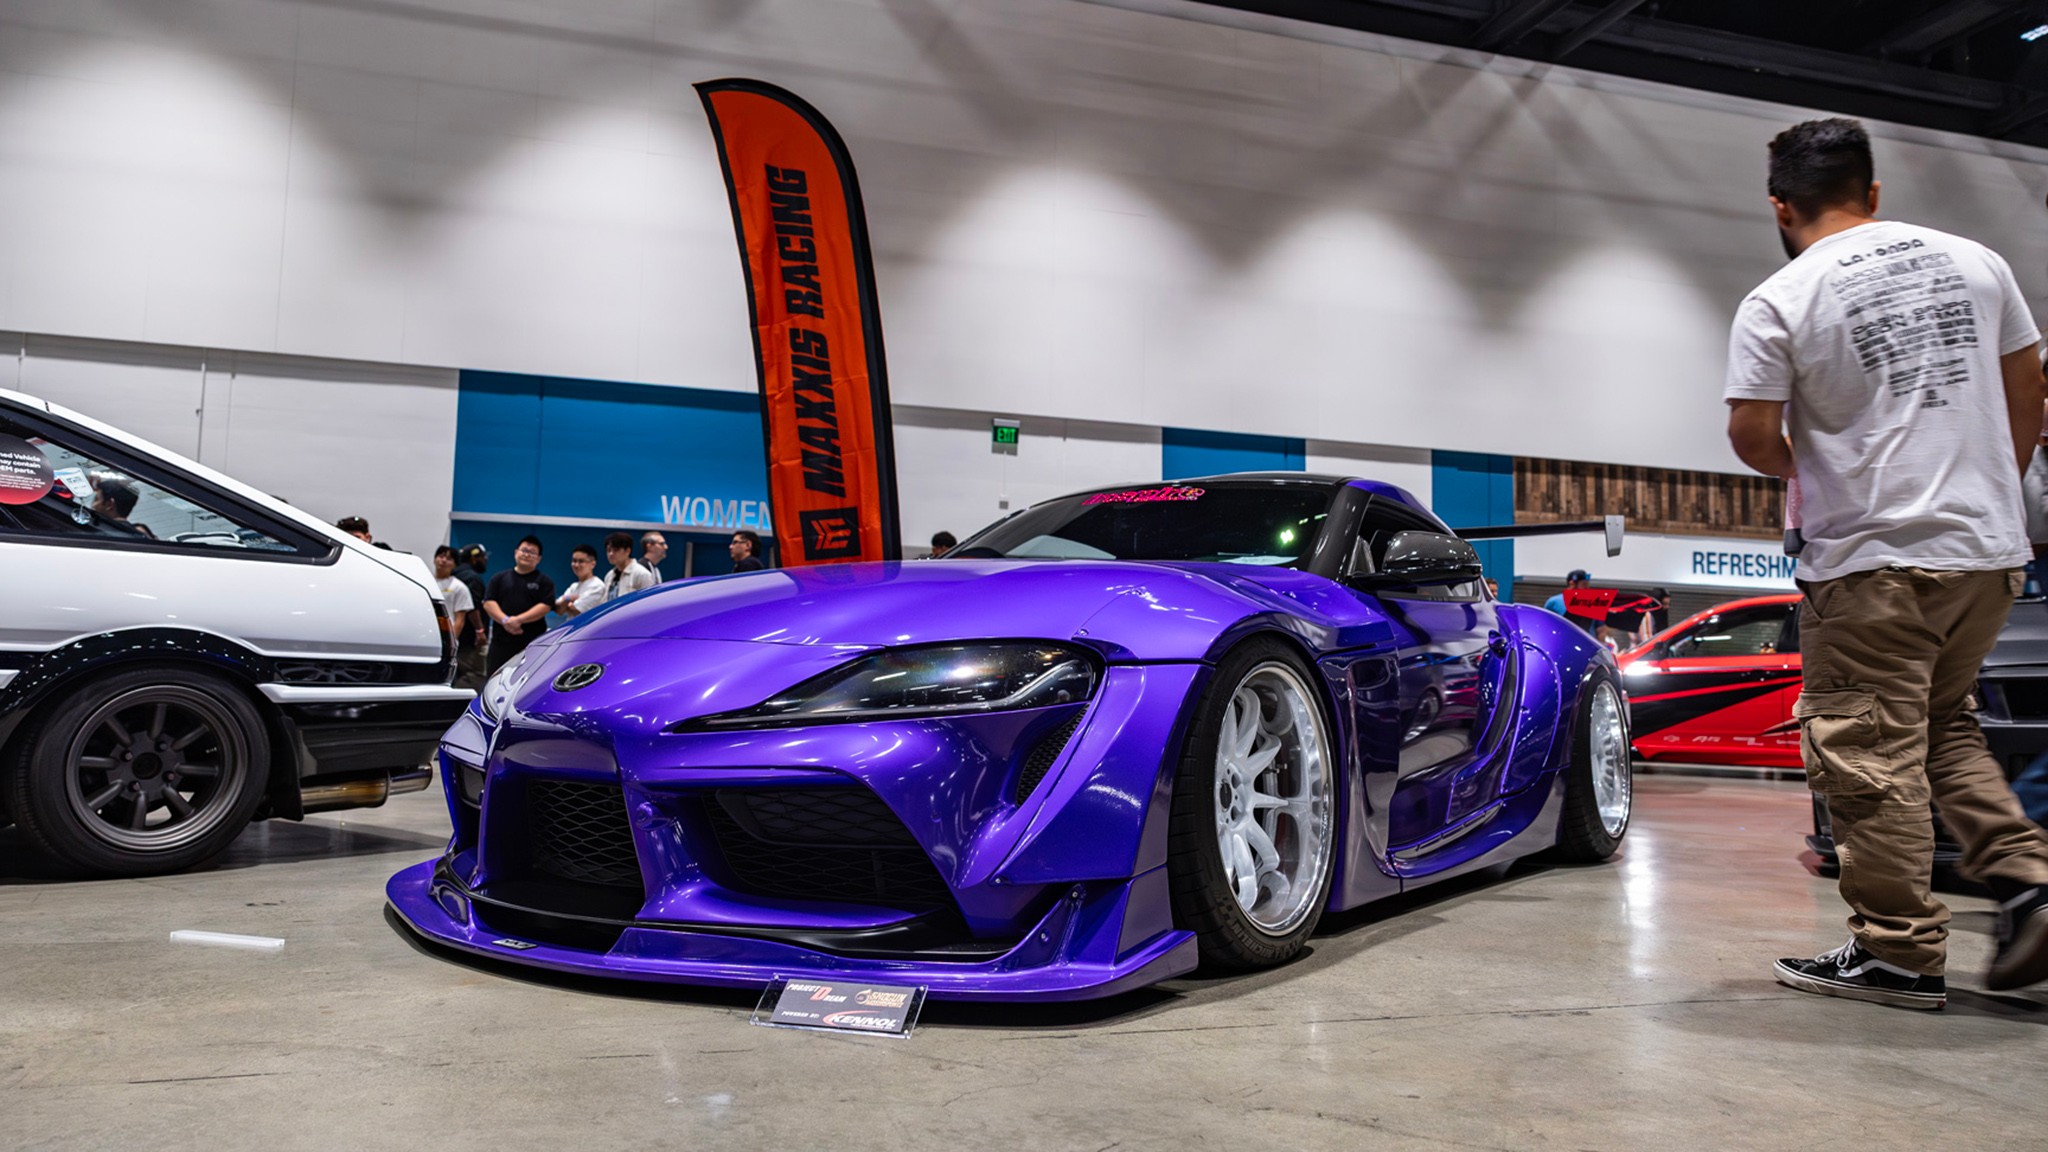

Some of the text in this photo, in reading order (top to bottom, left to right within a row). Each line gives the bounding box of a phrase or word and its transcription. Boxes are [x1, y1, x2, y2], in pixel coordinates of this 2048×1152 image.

[764, 163, 846, 498] MAXXIS RACING
[997, 427, 1016, 443] EXIT
[13, 453, 41, 462] Vehicle
[12, 460, 41, 469] contain
[14, 467, 36, 475] parts.
[787, 983, 821, 993] PROJECT
[870, 991, 908, 1003] SHOGUN
[828, 1014, 897, 1027] KENNOL
